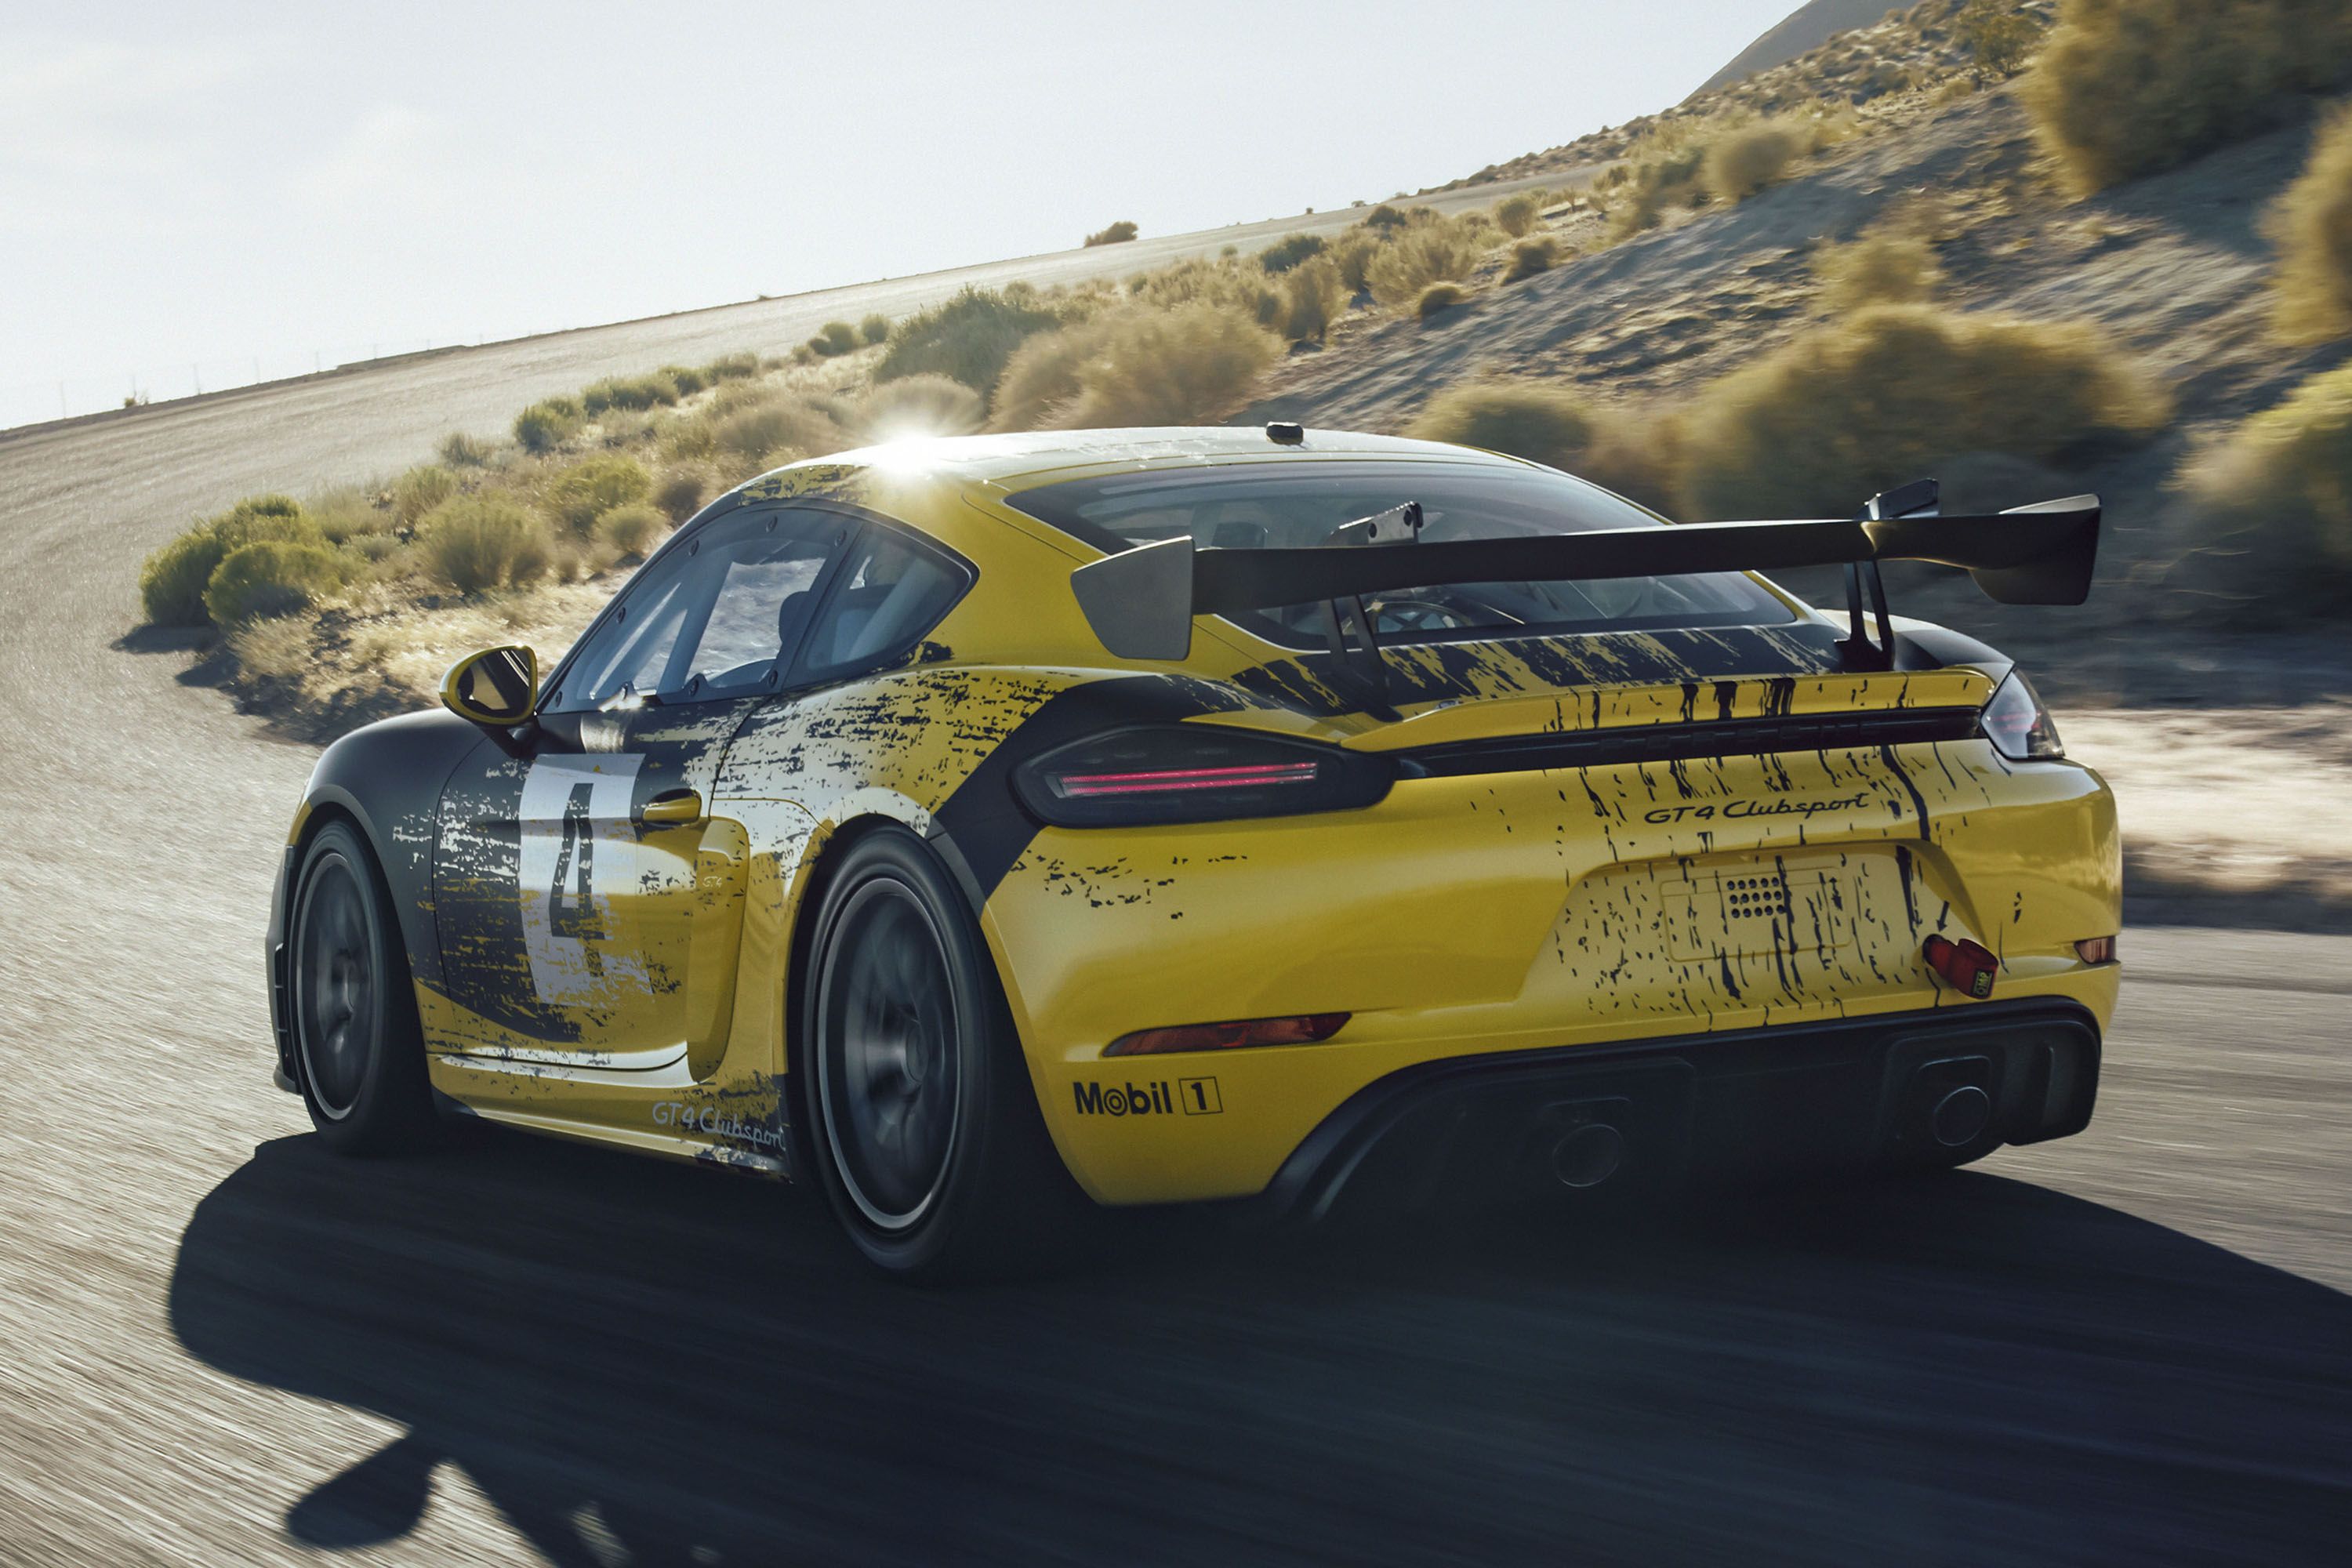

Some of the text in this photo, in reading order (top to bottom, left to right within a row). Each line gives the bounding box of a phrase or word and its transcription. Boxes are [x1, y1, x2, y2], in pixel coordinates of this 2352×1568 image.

[1722, 792, 1870, 819] Clubsport
[1976, 971, 1990, 996] OMP
[1072, 1081, 1207, 1117] Mobil 1
[699, 1106, 786, 1152] Clubsport
